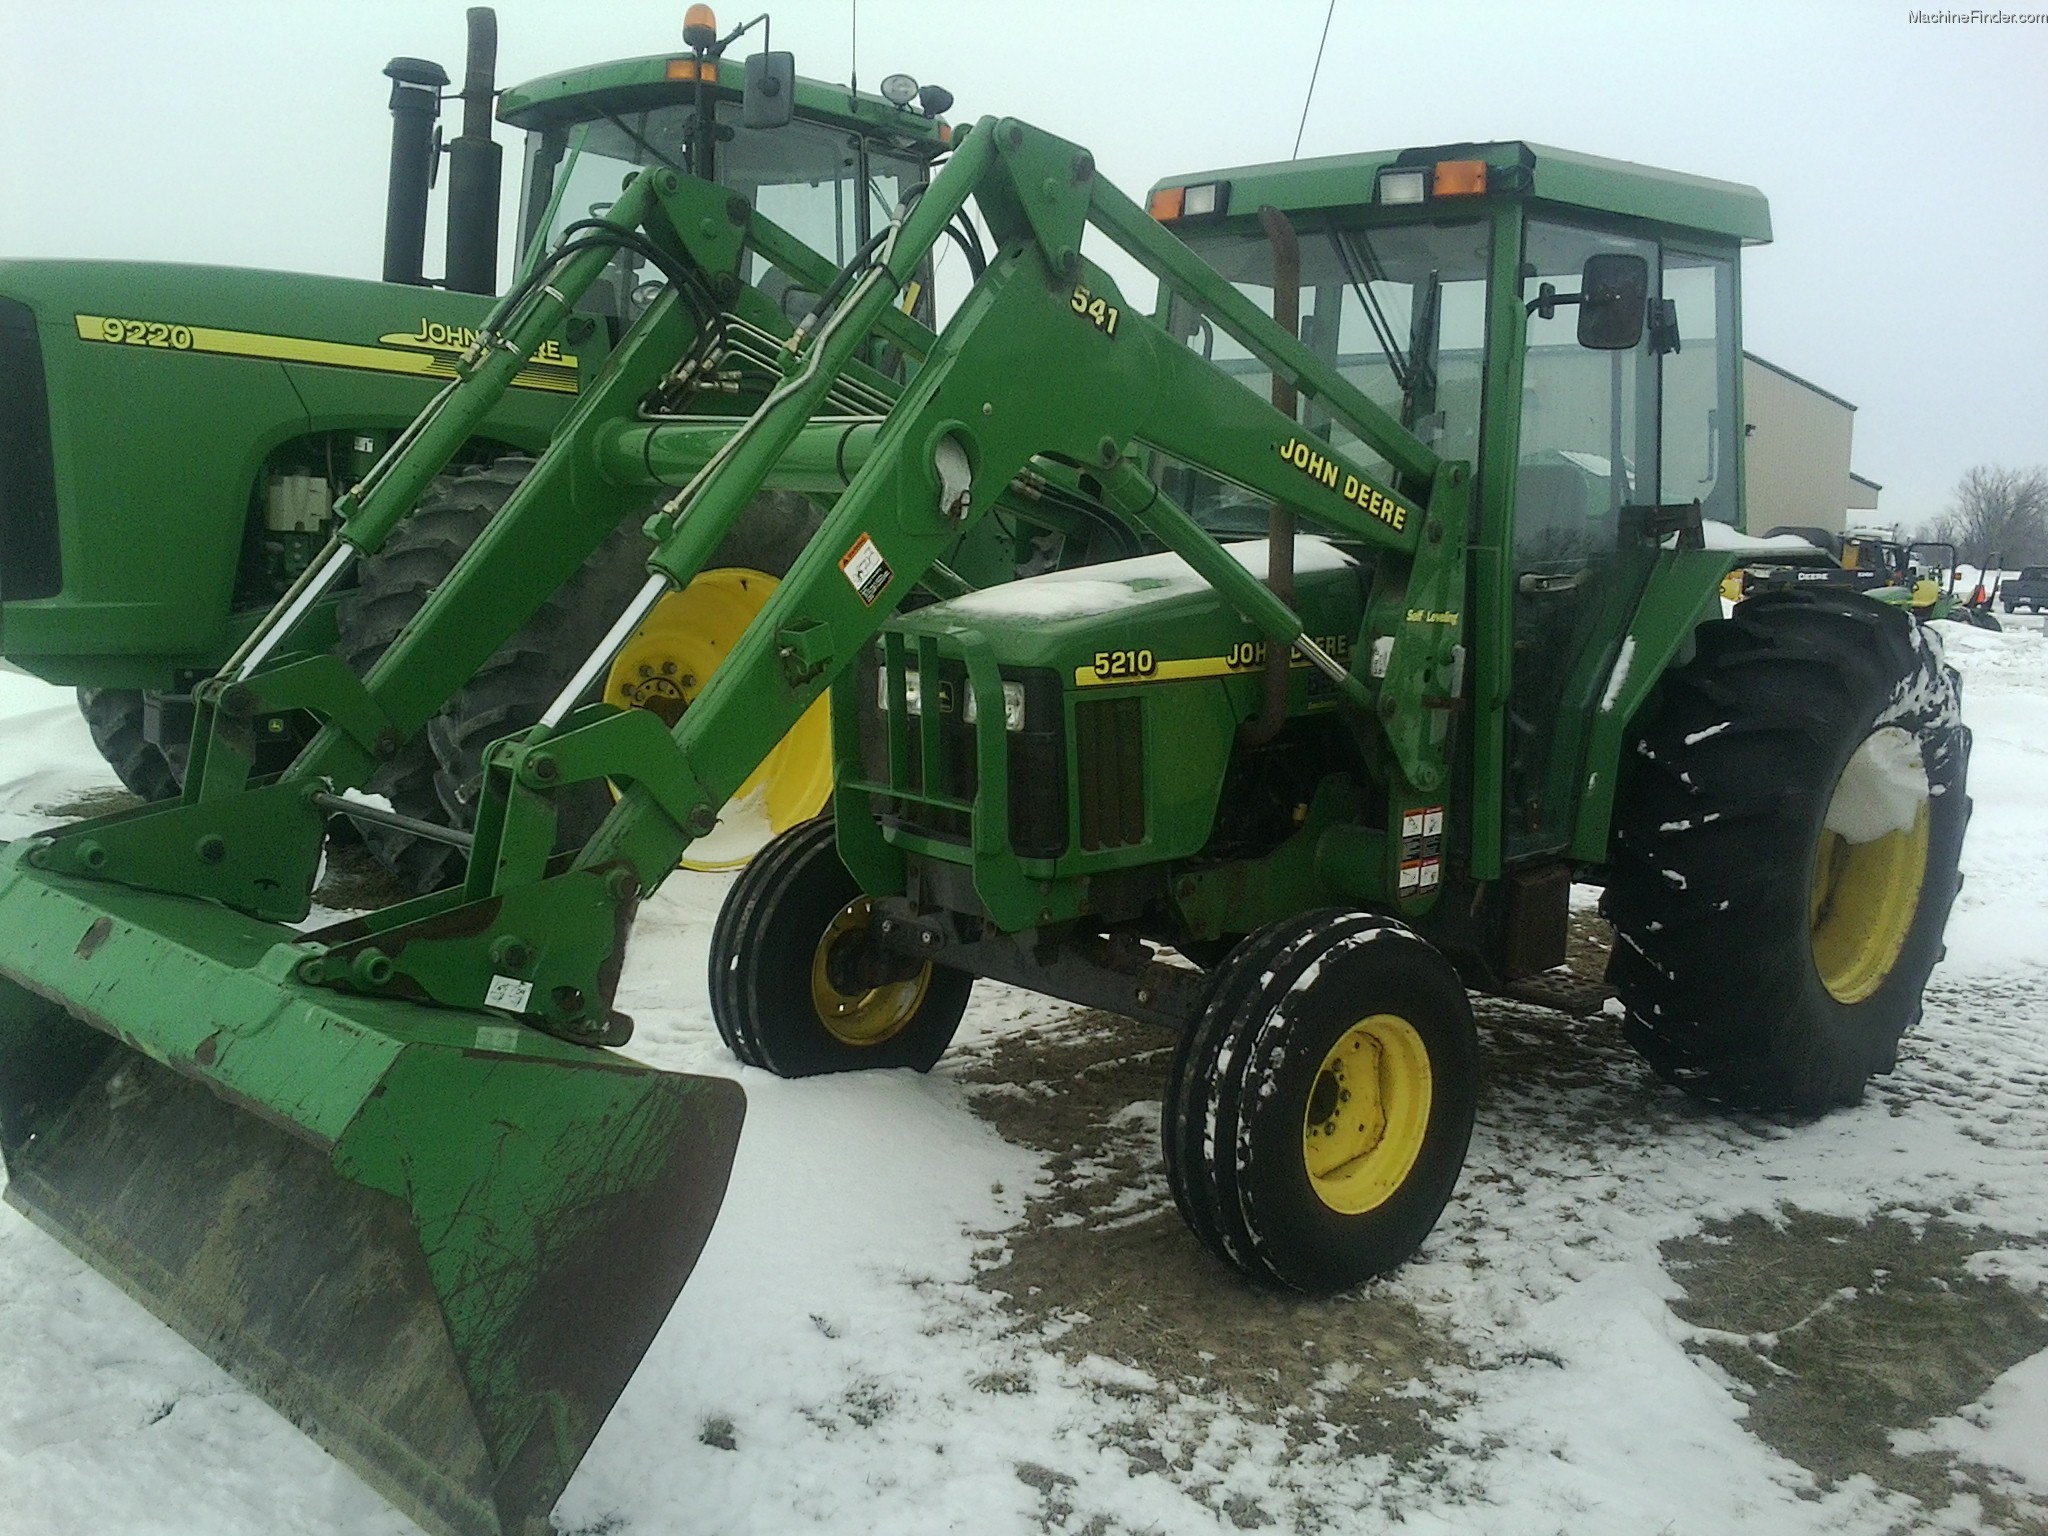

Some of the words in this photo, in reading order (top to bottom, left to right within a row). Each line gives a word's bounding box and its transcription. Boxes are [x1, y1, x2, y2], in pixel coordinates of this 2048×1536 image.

[1070, 284, 1119, 334] 541
[102, 317, 193, 350] 9220
[1280, 438, 1340, 489] JOHN
[1343, 475, 1408, 531] DEERE
[1094, 650, 1156, 677] 5210
[1227, 642, 1267, 667] JOH
